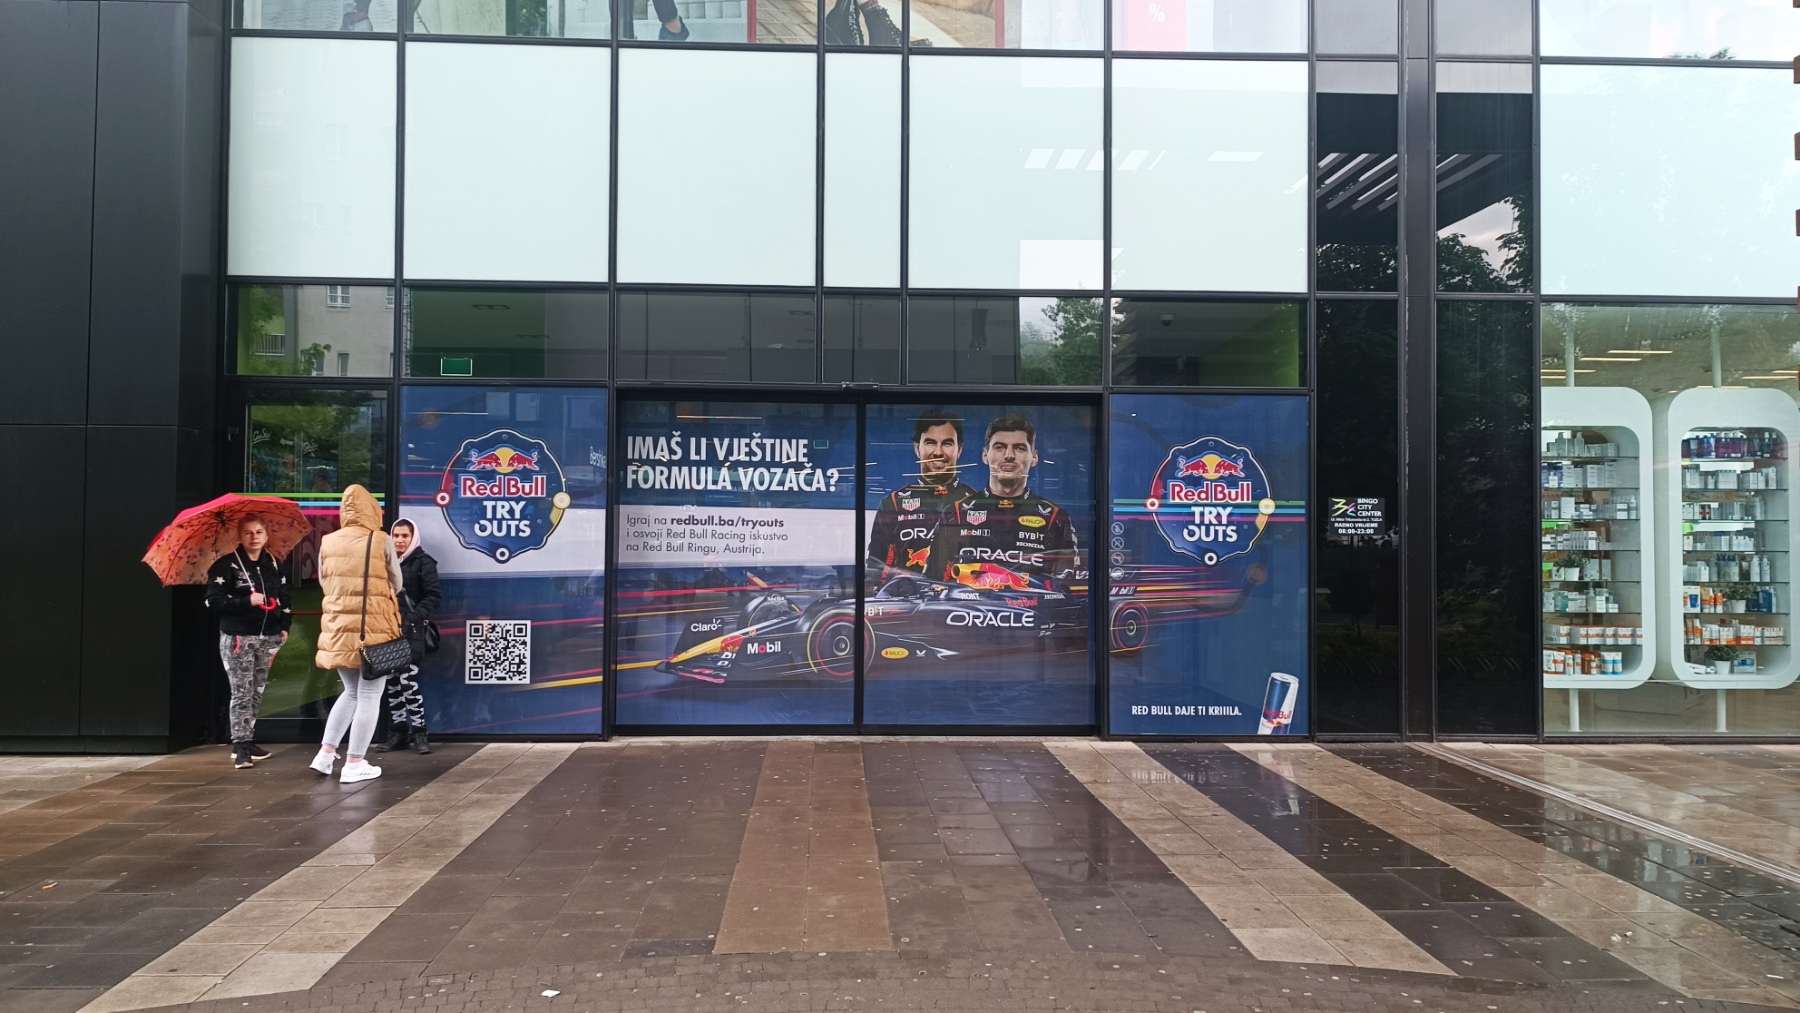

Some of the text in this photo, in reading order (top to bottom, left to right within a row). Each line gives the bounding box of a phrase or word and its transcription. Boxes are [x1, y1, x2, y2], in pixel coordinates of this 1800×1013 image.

[627, 431, 809, 462] IMAŠ LI VJEŠTINE
[626, 463, 839, 492] FORMULA VOZAČA?
[461, 475, 547, 498] Red Bull
[1170, 481, 1252, 503] Red Bull
[483, 501, 527, 519] TRY
[897, 513, 917, 521] Mobil
[1190, 506, 1233, 524] TRY
[474, 519, 531, 537] OUTS
[626, 514, 651, 527] Igraj
[670, 514, 785, 529] redbull.ba/tryouts
[632, 529, 663, 541] osvoji
[667, 529, 686, 539] Red
[689, 529, 708, 539] Bull
[711, 531, 746, 543] Racing
[749, 530, 789, 541] iskustvo
[960, 529, 981, 537] Mobil
[1018, 531, 1045, 541] BYBIT
[1182, 525, 1238, 542] OUTS
[626, 542, 765, 556] na Red Bull Ringu, Austrija.
[1015, 541, 1046, 549] HONDA
[1005, 597, 1038, 607] Red Bull
[690, 619, 722, 632] Claro
[945, 611, 1035, 627] ORACLE
[746, 641, 782, 655] Mobil
[1131, 705, 1243, 717] RED BULL DAJE TI KRIIILA.
